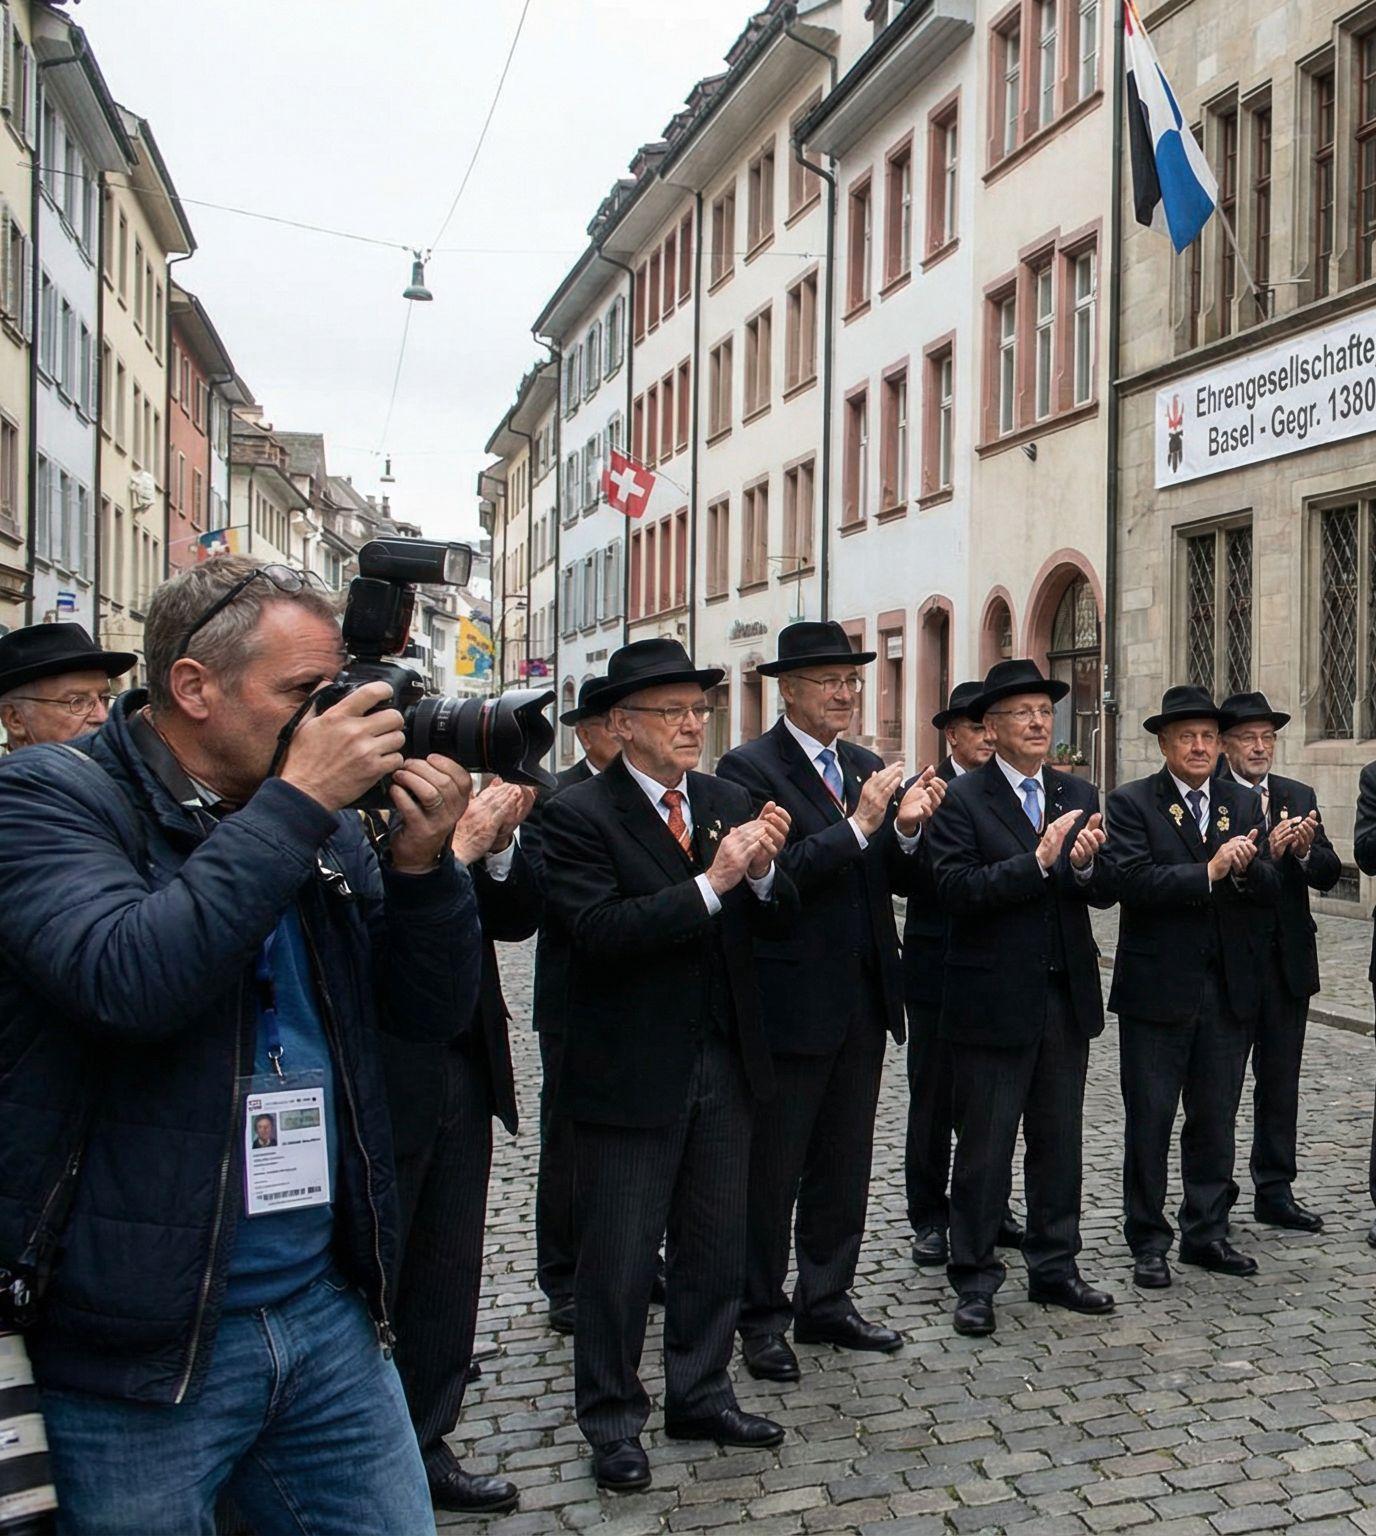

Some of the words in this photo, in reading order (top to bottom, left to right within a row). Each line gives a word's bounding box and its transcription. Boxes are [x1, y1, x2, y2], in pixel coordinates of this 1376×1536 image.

[1208, 413, 1254, 457] Basel
[1271, 402, 1321, 440] Gegr.
[1328, 376, 1376, 422] 1380
